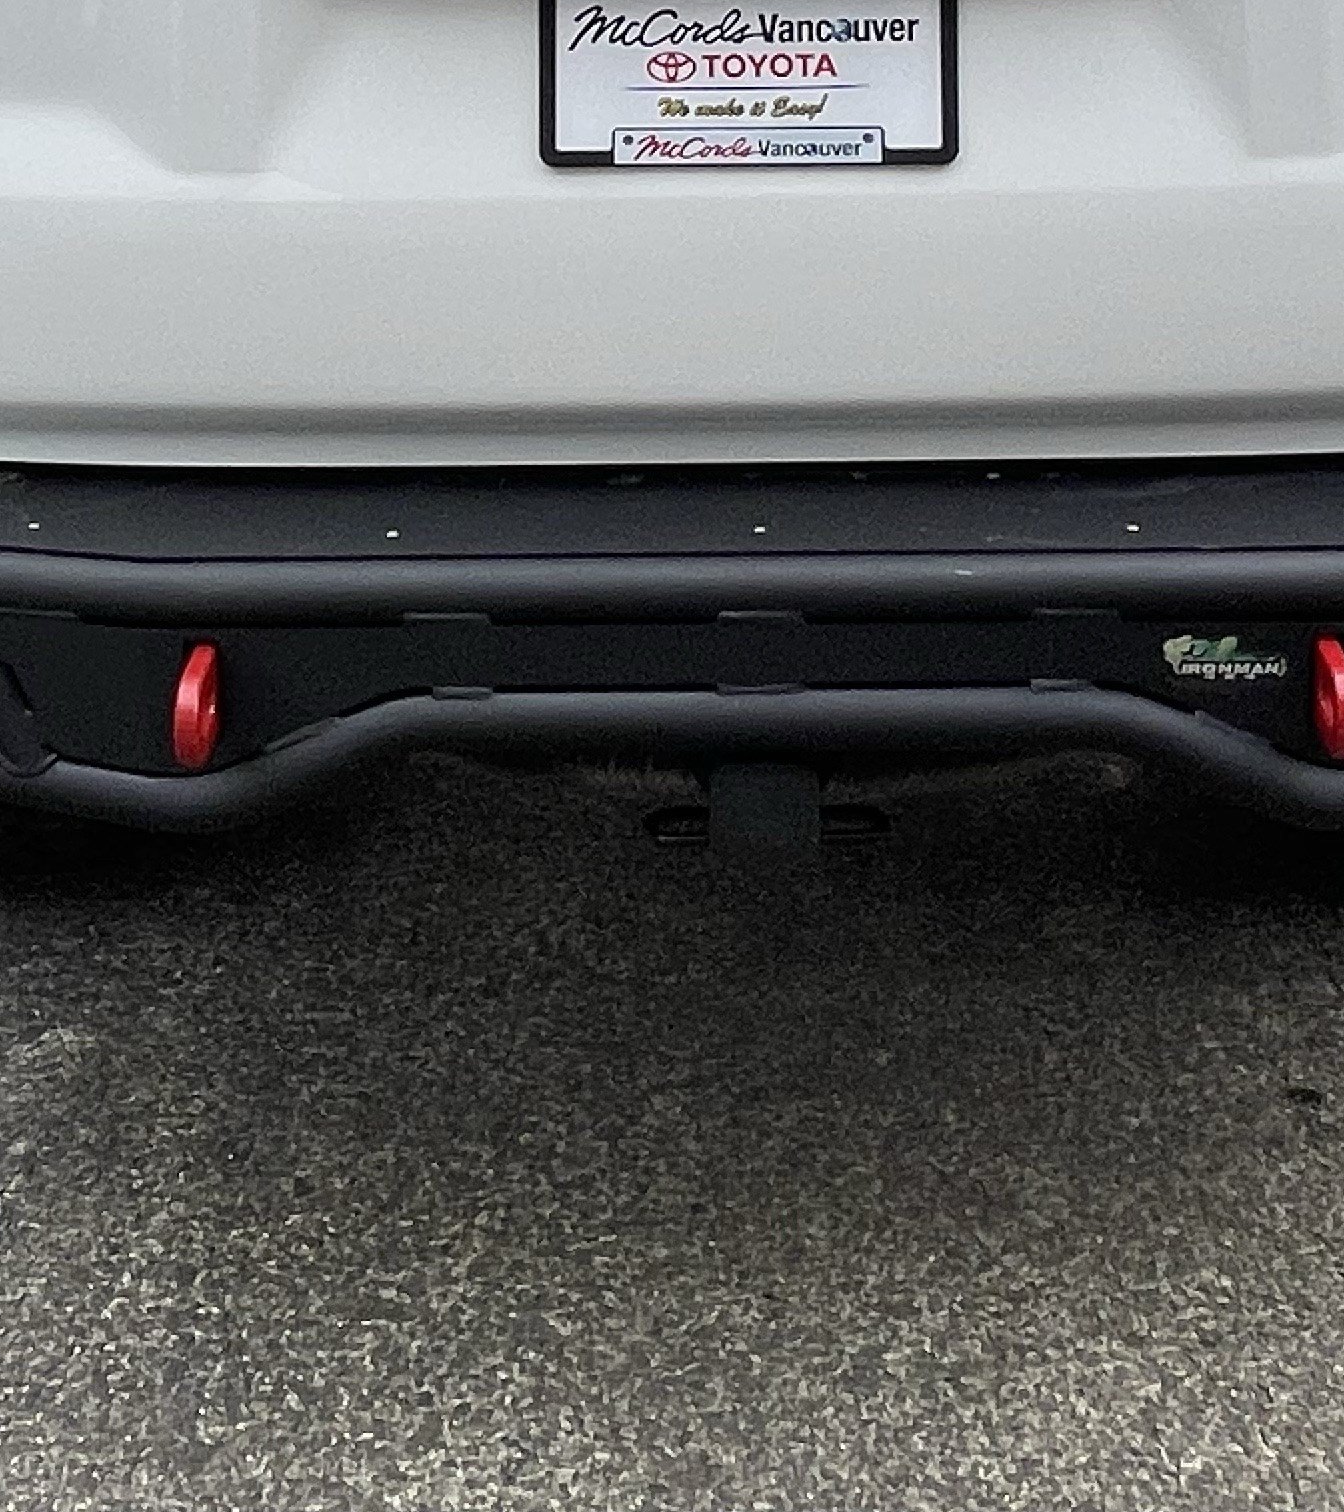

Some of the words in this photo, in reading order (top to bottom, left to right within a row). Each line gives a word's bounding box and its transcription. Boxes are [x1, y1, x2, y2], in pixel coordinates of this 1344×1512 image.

[702, 53, 837, 78] TOYOTA
[658, 96, 690, 117] We
[694, 97, 745, 117] make
[1180, 662, 1280, 679] IRONMAN
